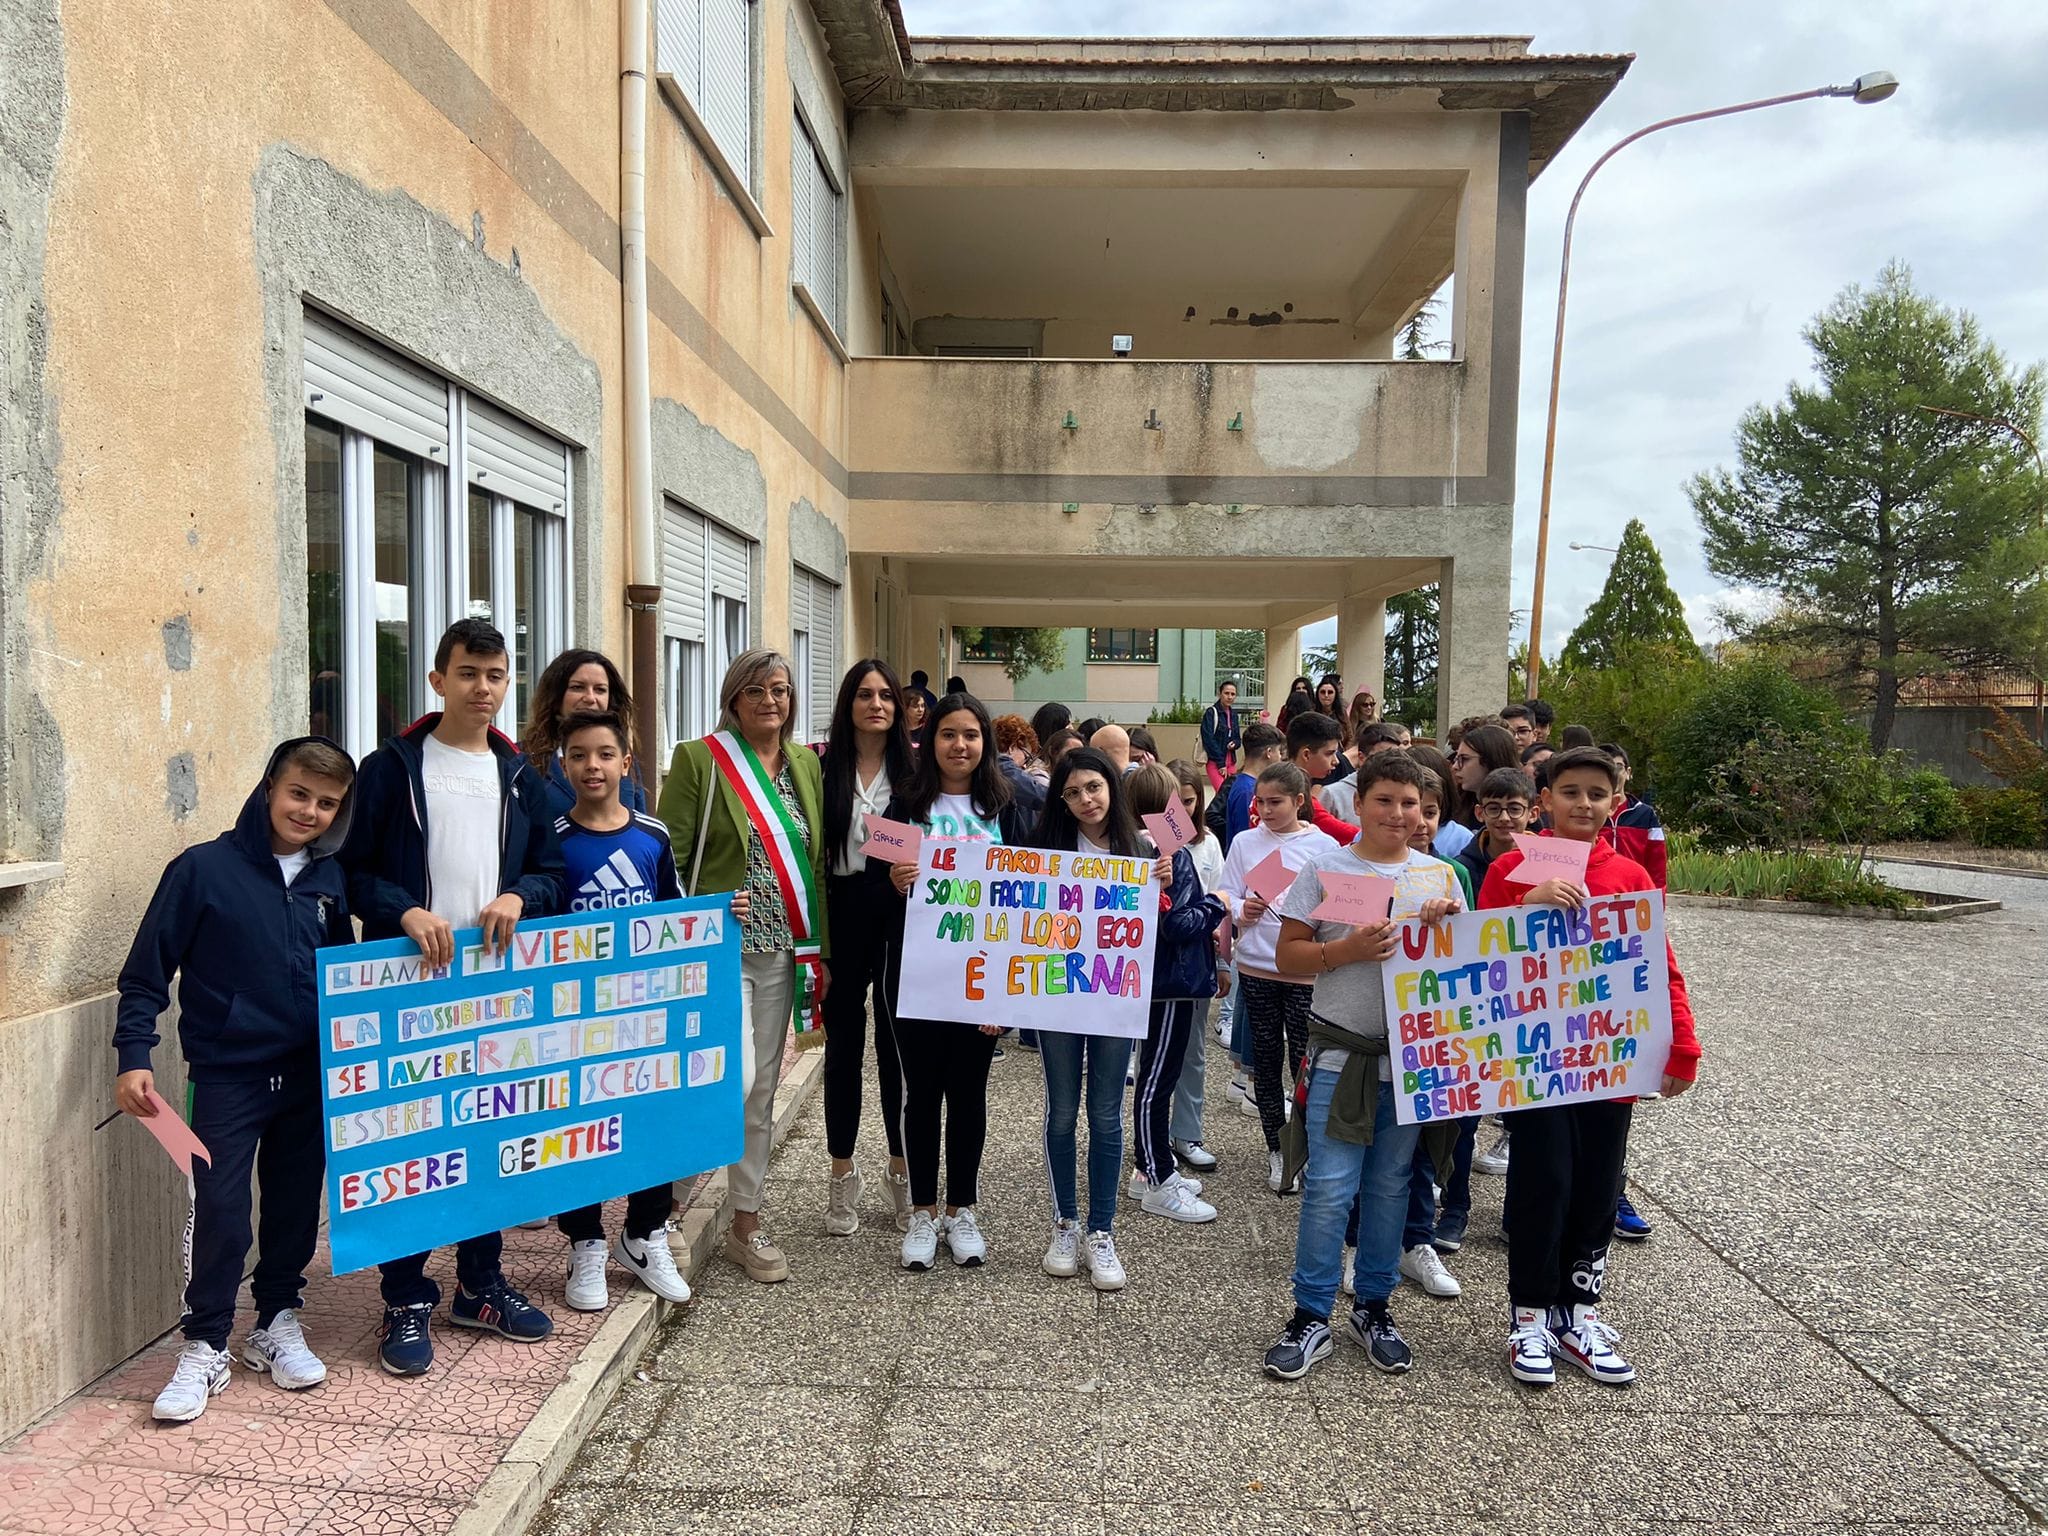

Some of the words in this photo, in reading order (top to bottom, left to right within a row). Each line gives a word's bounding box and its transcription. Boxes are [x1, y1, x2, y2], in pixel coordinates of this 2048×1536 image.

[425, 774, 499, 799] GUES
[873, 830, 905, 848] GRAZIE
[1528, 848, 1581, 866] PERMESSO
[931, 847, 957, 872] LE
[986, 847, 1062, 877] PAROLE
[1072, 856, 1149, 885] GENTILI
[571, 887, 653, 913] adidas
[925, 878, 981, 908] SONO
[990, 879, 1047, 910] FACILI
[1058, 883, 1083, 913] DA
[1094, 884, 1140, 911] DIRE
[464, 946, 502, 972] TI
[516, 925, 611, 965] VIENE
[633, 915, 720, 953] DATA
[936, 911, 975, 943] MA
[984, 912, 1009, 942] LA
[1021, 911, 1082, 950] LORO
[1096, 915, 1144, 949] ECO
[1402, 921, 1454, 961] UN
[1478, 898, 1652, 957] ALFABETO
[965, 949, 988, 1001] È
[1007, 951, 1141, 998] ETERNA
[1394, 959, 1508, 1011] FATTO
[1559, 935, 1643, 976] PAROLE
[1633, 959, 1650, 993] È
[333, 1017, 378, 1049] LA
[402, 989, 532, 1038] POSSIBILITÀ
[554, 981, 579, 1014] DI
[597, 963, 707, 1010] SCEGLIERE
[339, 1064, 367, 1093] SE
[391, 1049, 473, 1085] AVERE
[479, 1013, 666, 1069] RAGIONE
[1402, 1032, 1503, 1071] QUESTA
[1516, 1022, 1551, 1054] LA
[1403, 1064, 1471, 1095] DELLA
[1611, 1037, 1638, 1063] FA
[335, 1098, 434, 1146] ESSERE
[454, 1077, 570, 1122] GENTILE
[586, 1055, 679, 1101] SCEGLI
[691, 1051, 721, 1082] DI
[1413, 1081, 1482, 1122] BENE
[343, 1152, 465, 1208] ESSERE
[500, 1116, 621, 1174] GENTILE
